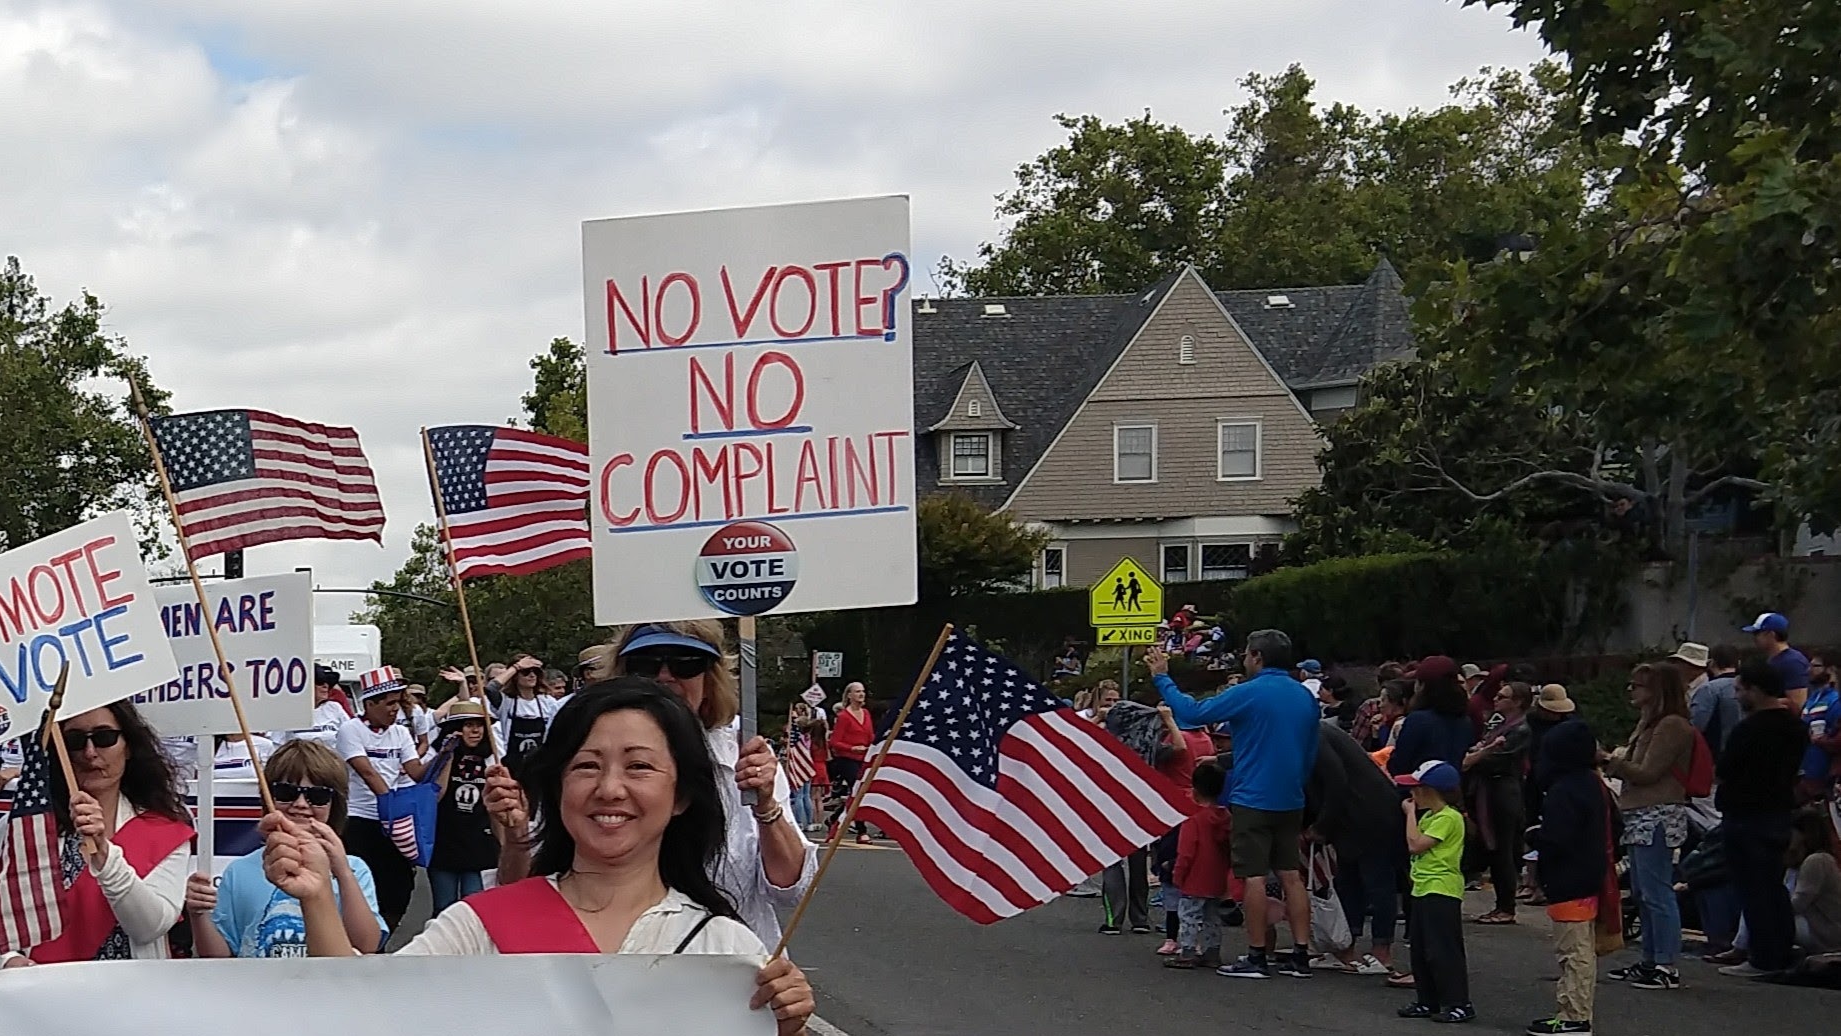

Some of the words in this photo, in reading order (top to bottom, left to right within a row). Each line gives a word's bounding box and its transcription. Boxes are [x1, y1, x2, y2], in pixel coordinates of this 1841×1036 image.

[606, 271, 701, 356] NO
[720, 251, 910, 342] VOTE?
[688, 350, 806, 434] NO
[600, 431, 909, 526] COMPLAINT
[722, 535, 772, 550] YOUR
[710, 558, 784, 580] VOTE
[215, 590, 276, 633] ARE
[713, 586, 783, 601] COUNTS
[1119, 629, 1153, 642] XING
[245, 657, 307, 698] TOO
